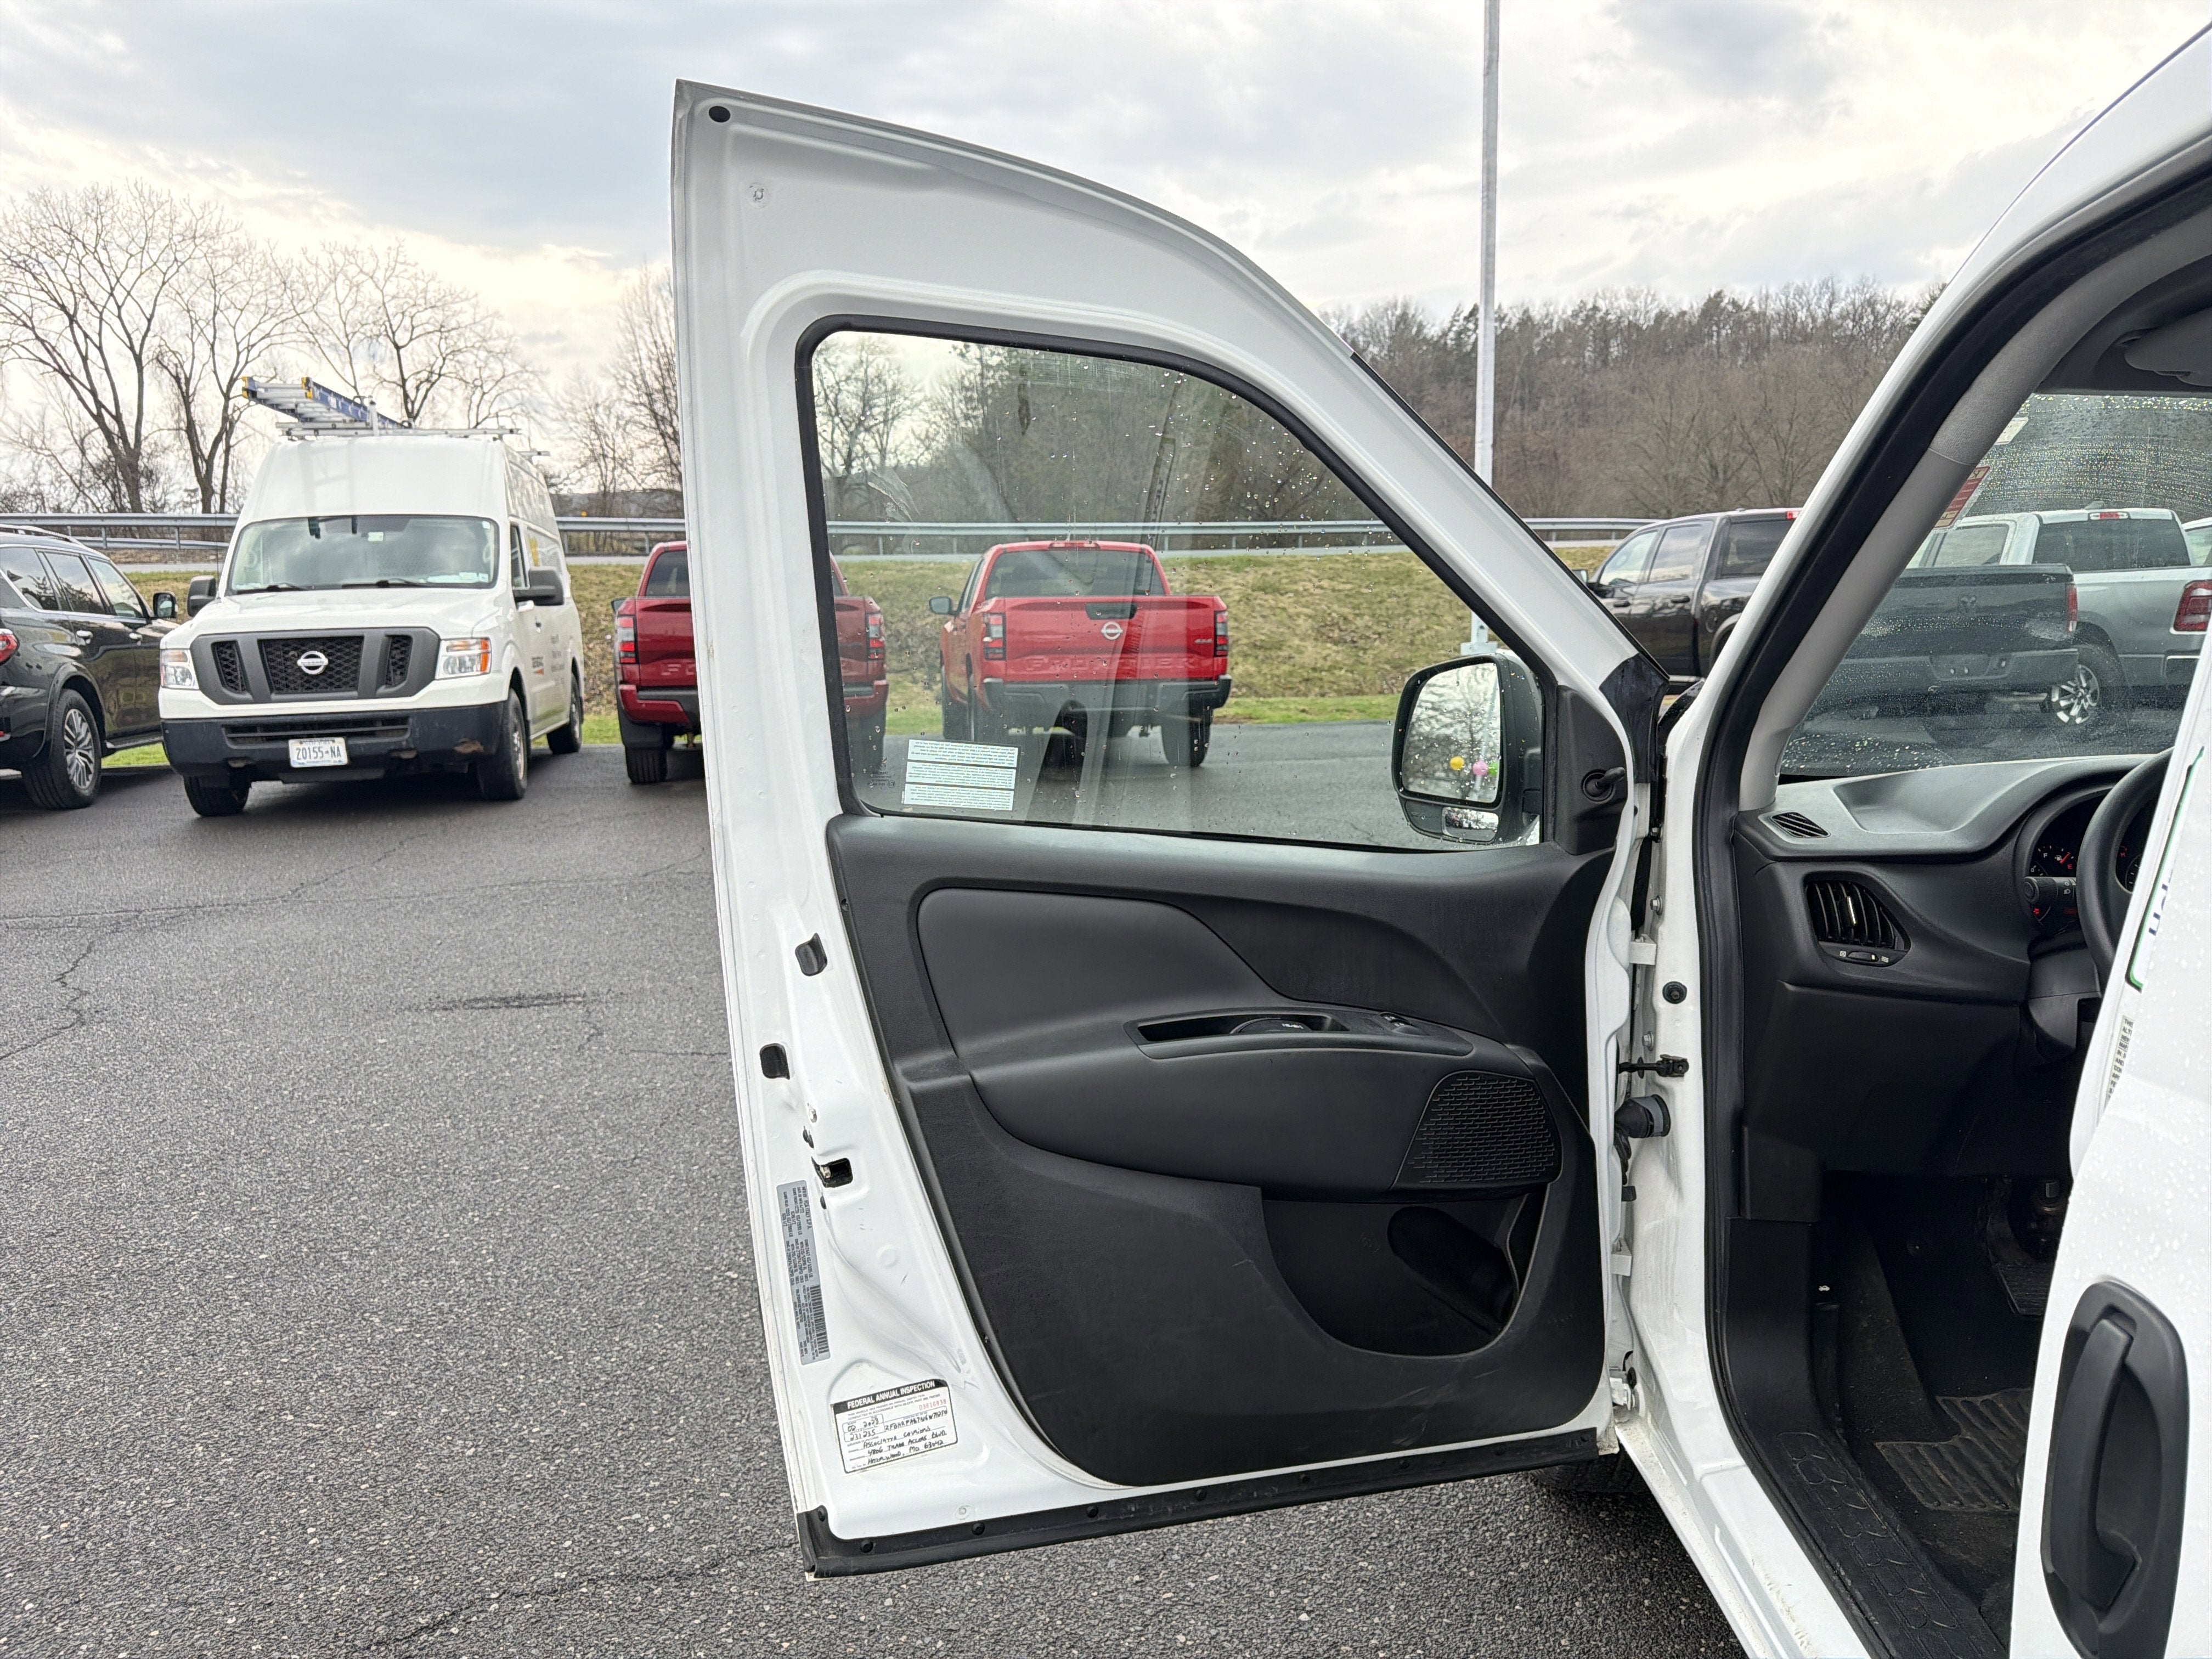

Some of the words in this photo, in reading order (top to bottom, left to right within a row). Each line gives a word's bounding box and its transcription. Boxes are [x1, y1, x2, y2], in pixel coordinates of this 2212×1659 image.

[848, 1400, 874, 1408] FEDERAL
[876, 1390, 899, 1401] ANNUAL
[900, 1381, 935, 1395] INSPECTION
